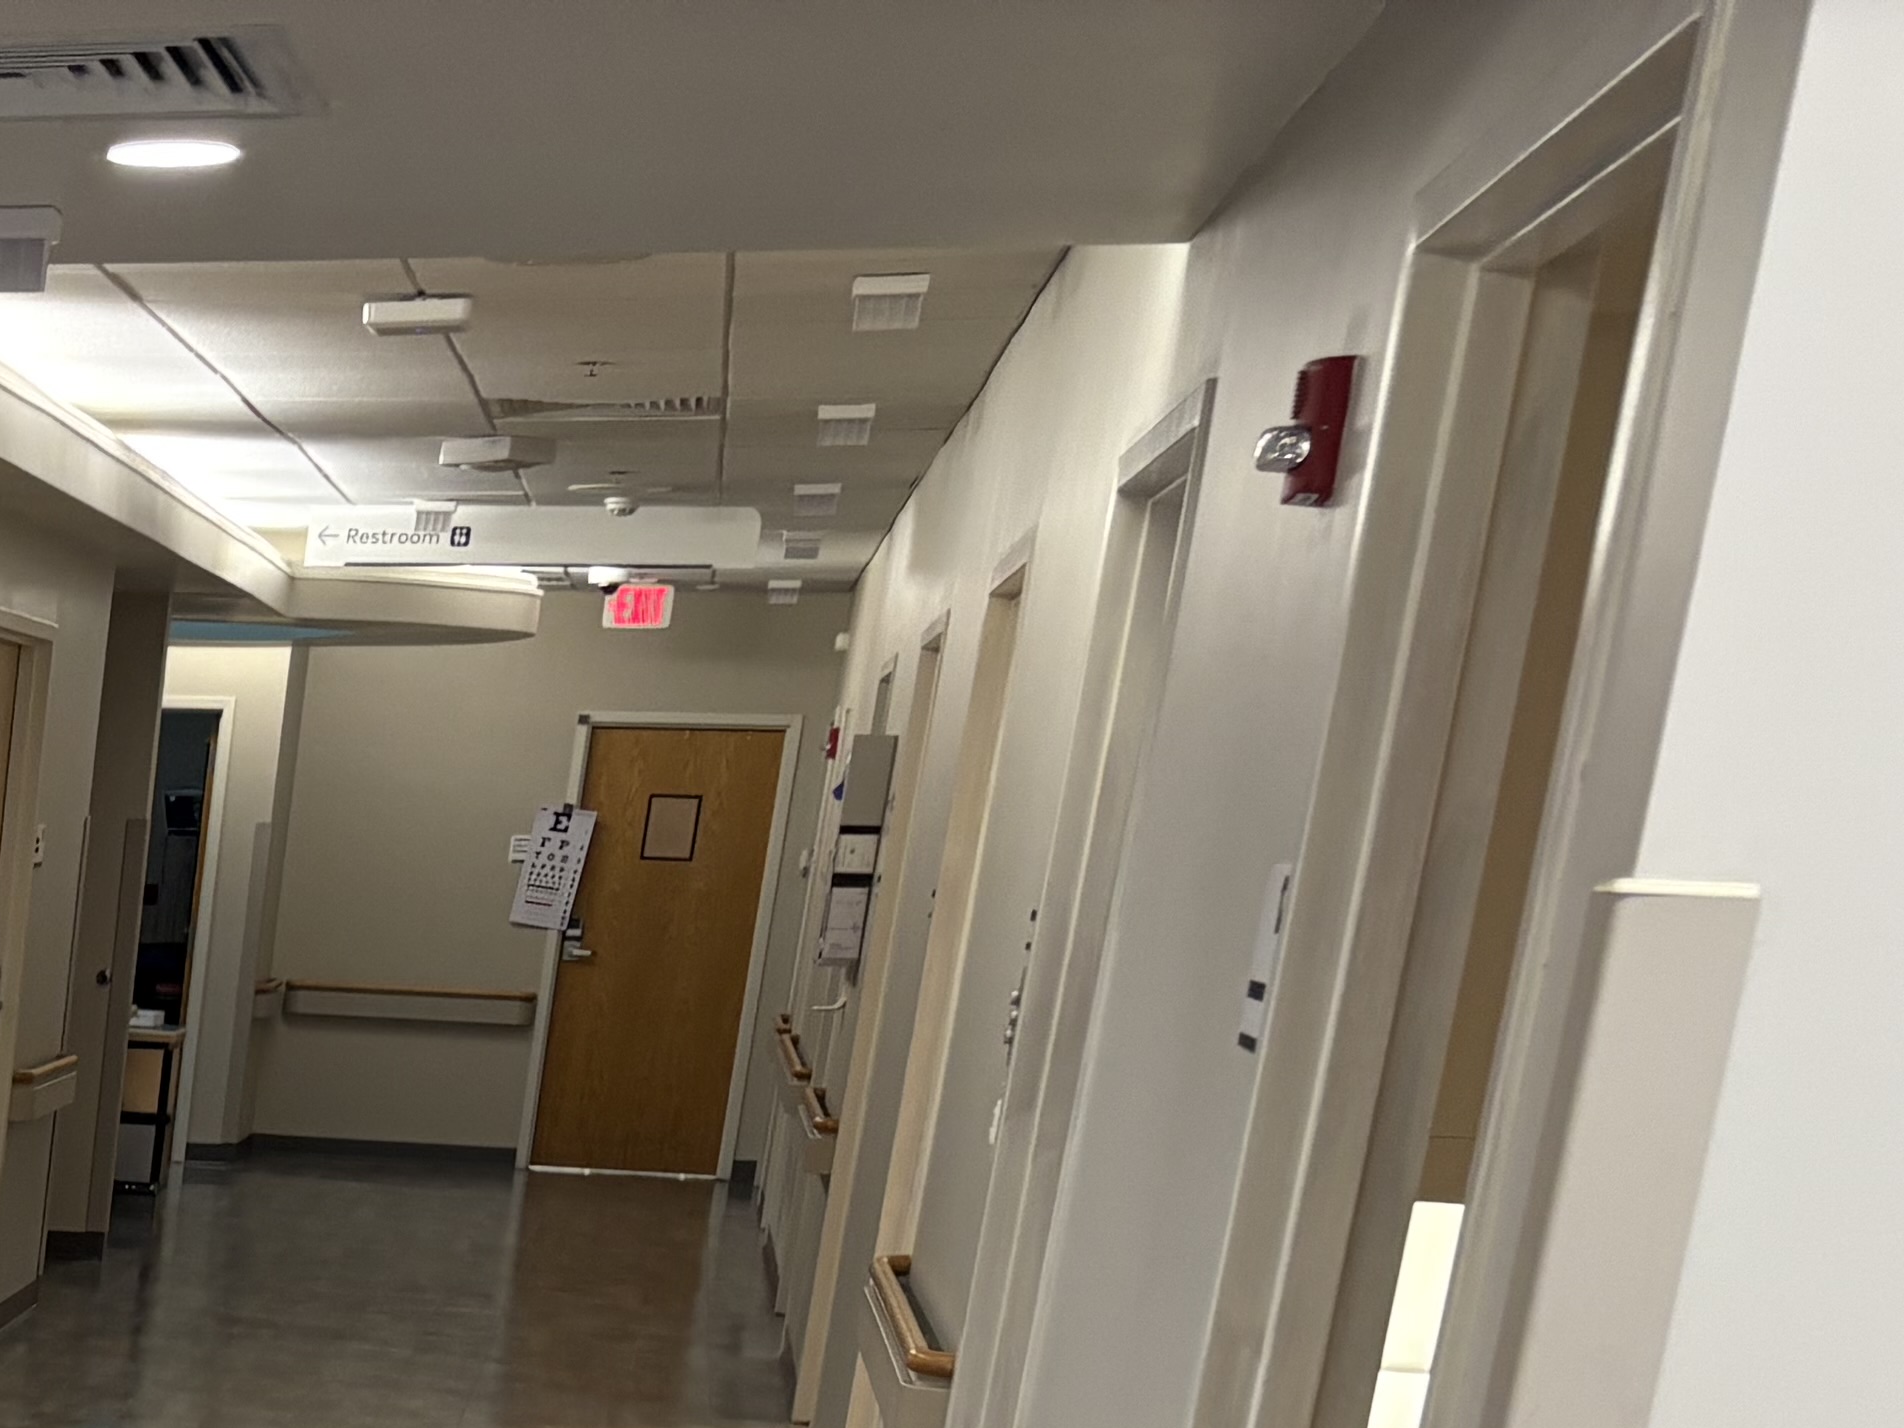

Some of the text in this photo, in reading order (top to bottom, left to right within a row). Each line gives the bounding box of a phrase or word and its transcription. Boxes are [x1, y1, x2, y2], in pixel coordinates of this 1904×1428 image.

[345, 527, 440, 545] Restroom
[613, 586, 669, 627] EXIT
[549, 811, 573, 833] E
